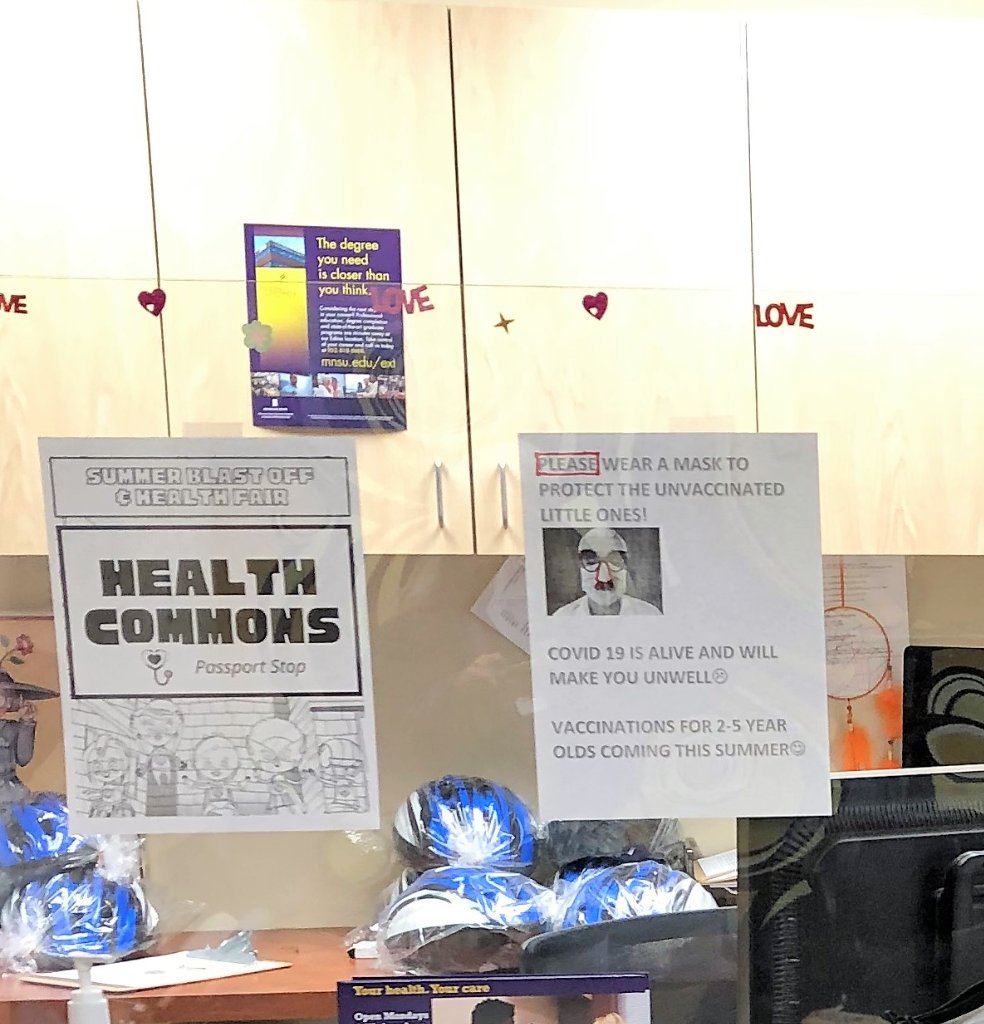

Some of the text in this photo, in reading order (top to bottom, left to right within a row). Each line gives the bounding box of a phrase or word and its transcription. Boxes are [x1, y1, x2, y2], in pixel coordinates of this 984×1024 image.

[316, 236, 379, 253] The degree
[317, 253, 369, 267] you need
[318, 267, 390, 281] is closer than
[318, 283, 372, 297] you think.
[371, 284, 434, 314] LOVE
[754, 302, 815, 329] LOVE
[538, 456, 749, 472] PLEASE WEAR A MASK TO
[86, 467, 314, 485] SUMMER BLAST OFF
[135, 488, 228, 506] HEALTH
[233, 489, 289, 506] FAIR
[539, 482, 785, 497] PROTECT THE UNVACCINATED
[541, 507, 648, 522] LITTLE ONES!
[99, 559, 317, 597] HEALTH
[84, 607, 341, 646] COMMONS
[548, 645, 778, 661] COVID 19 IS ALIVE AND WILL
[195, 658, 306, 677] Passport Stop
[550, 670, 711, 686] MAKE YOU UNWELL
[551, 718, 787, 735] VACCINATIONS FOR 2-5 YEAR
[553, 743, 790, 759] OLDS COMING THIS SUMMER
[353, 985, 384, 996] Your
[430, 983, 459, 995] Your
[461, 985, 490, 994] care
[353, 1012, 382, 1022] Open
